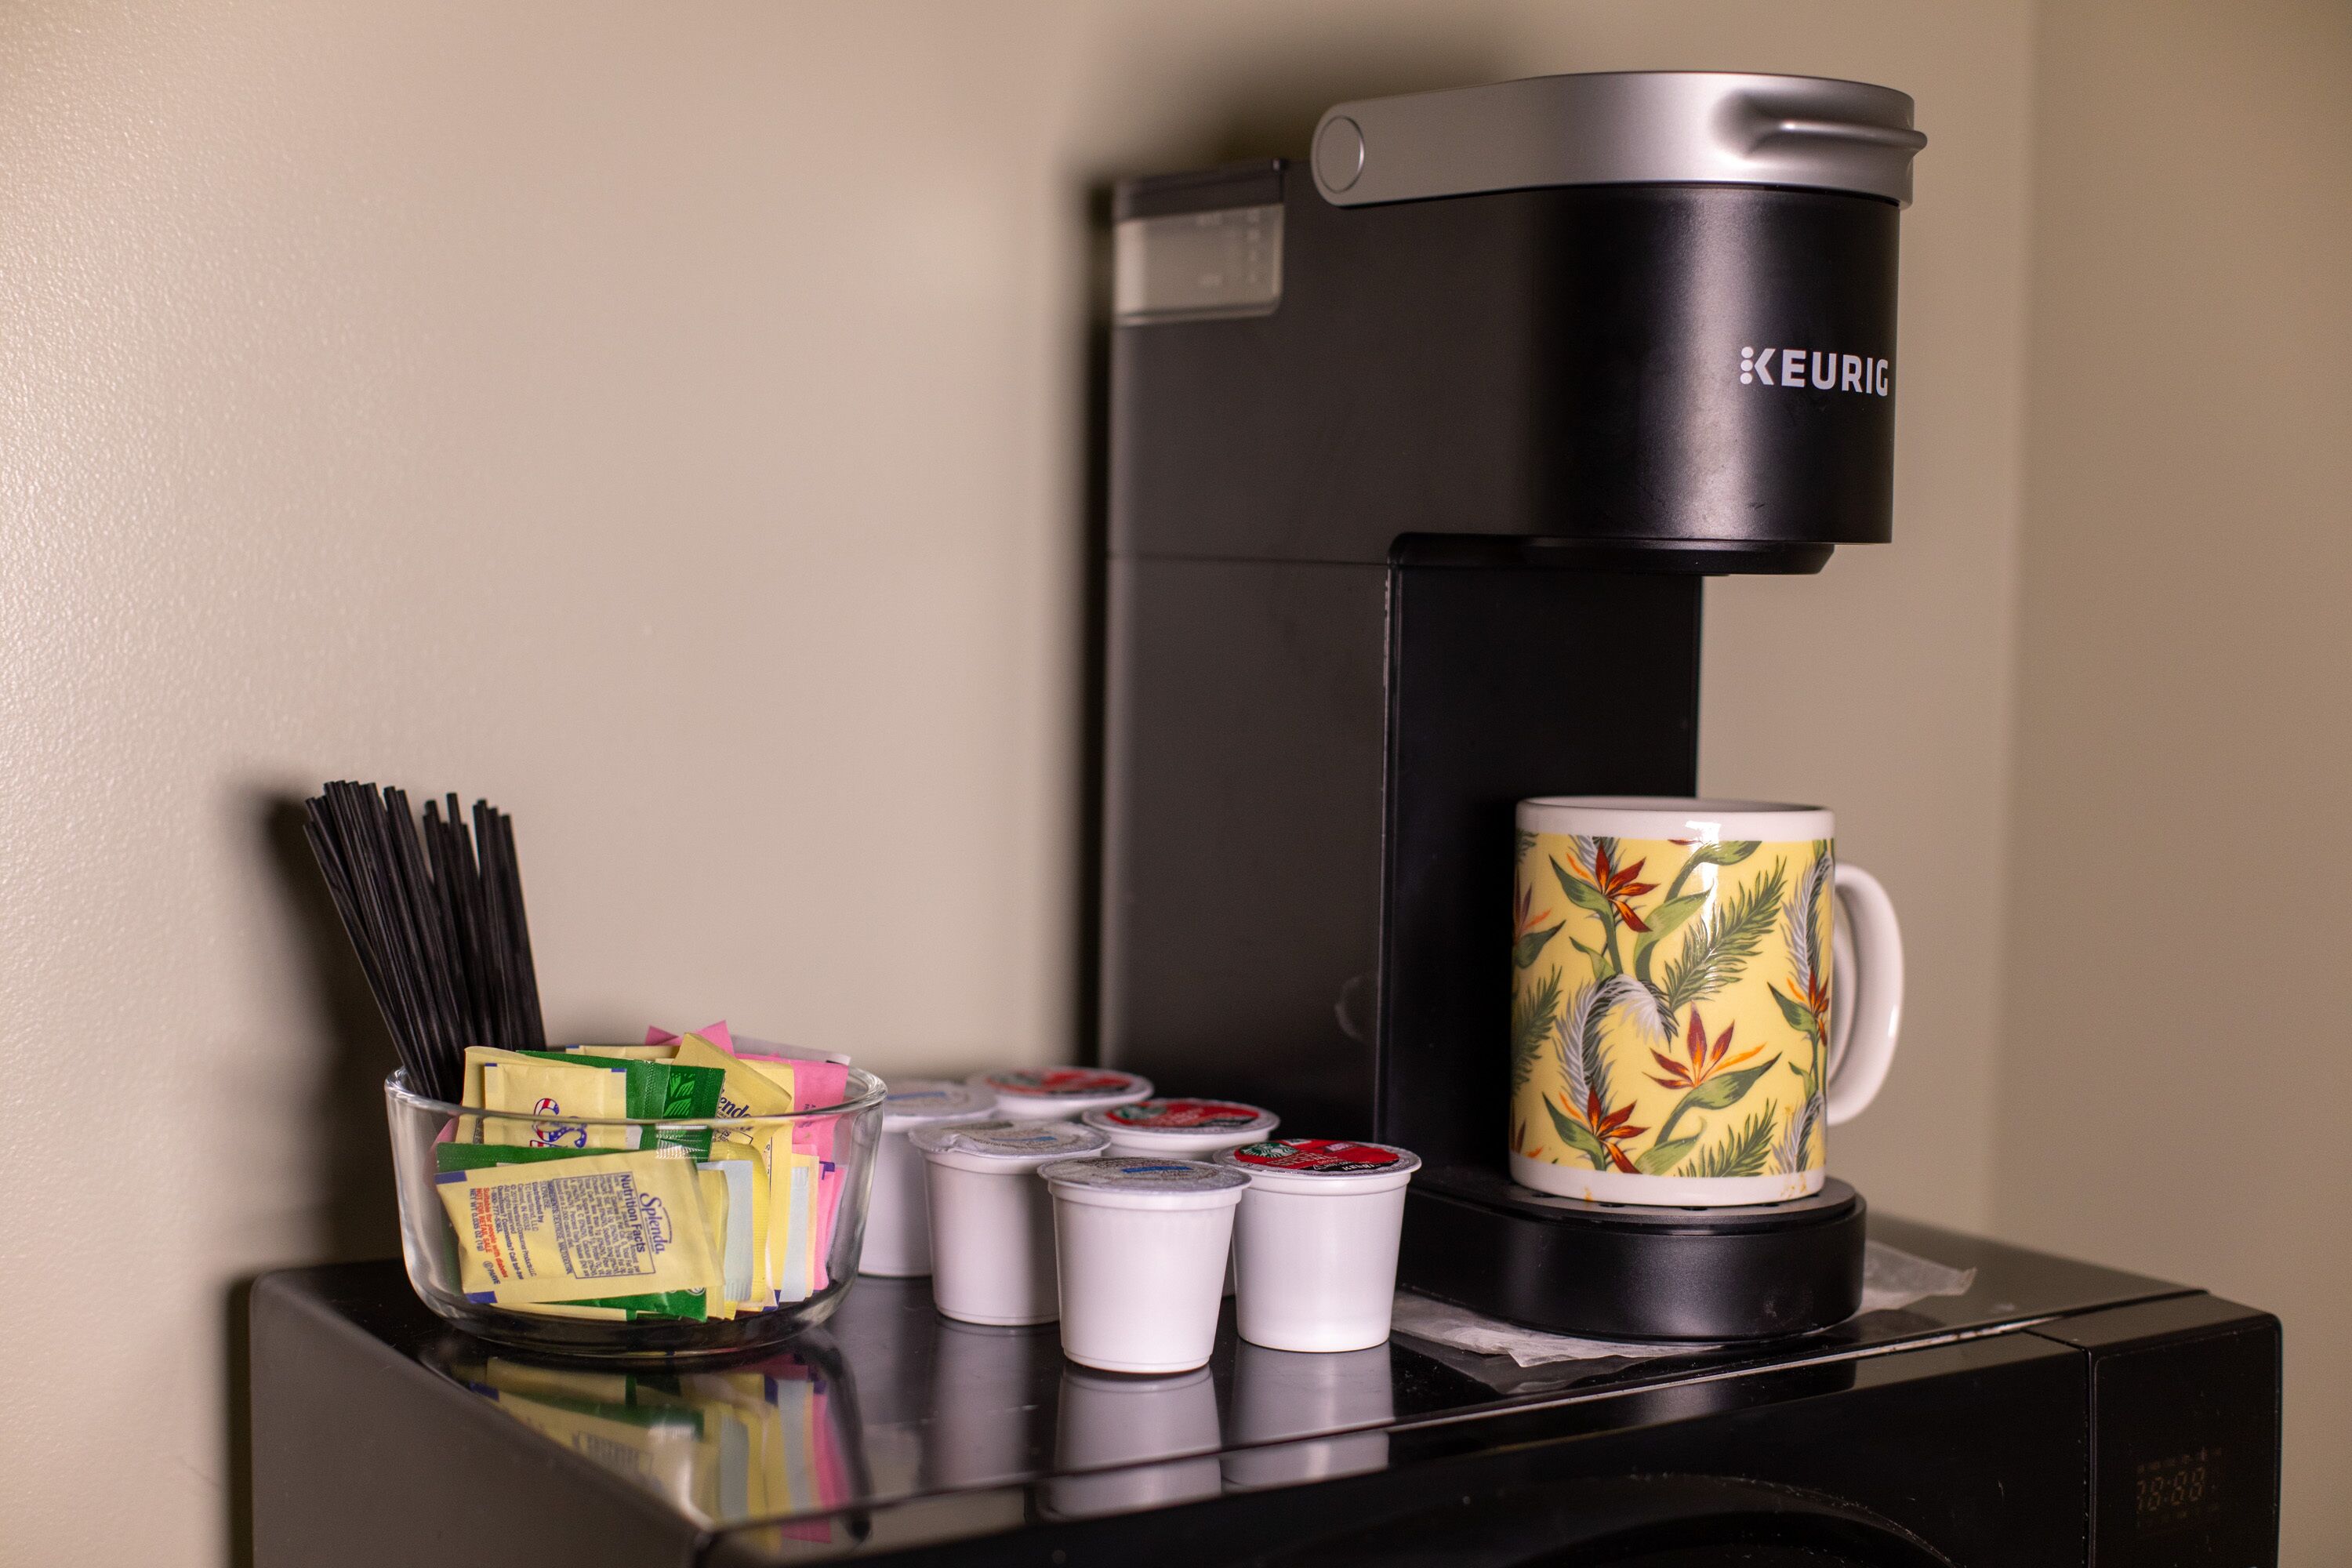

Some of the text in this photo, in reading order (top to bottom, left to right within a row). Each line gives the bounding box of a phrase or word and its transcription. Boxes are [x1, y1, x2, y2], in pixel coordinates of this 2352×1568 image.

[1740, 346, 1889, 397] KEURIG
[524, 1182, 532, 1191] TC
[470, 1201, 479, 1211] WT
[481, 1187, 494, 1213] Suitable
[495, 1185, 510, 1217] Questions?
[503, 1192, 512, 1210] rights
[532, 1181, 543, 1214] Distributed
[471, 1212, 481, 1229] 0.035
[474, 1188, 492, 1253] NOT FOR RETAIL SALE
[513, 1203, 522, 1227] Heartland
[561, 1206, 569, 1221] 2,000
[569, 1210, 578, 1230] Percent
[620, 1174, 645, 1253] Nutrition Facts
[640, 1192, 667, 1253] Splenda
[474, 1230, 483, 1239] OZ
[487, 1224, 496, 1243] people
[502, 1218, 514, 1250] Comments?
[517, 1227, 527, 1250] Consumer
[602, 1228, 611, 1246] Sodium
[509, 1251, 517, 1262] Call
[583, 1240, 591, 1259] Calcium
[630, 1244, 639, 1264] Amount
[488, 1269, 501, 1284] PARVE
